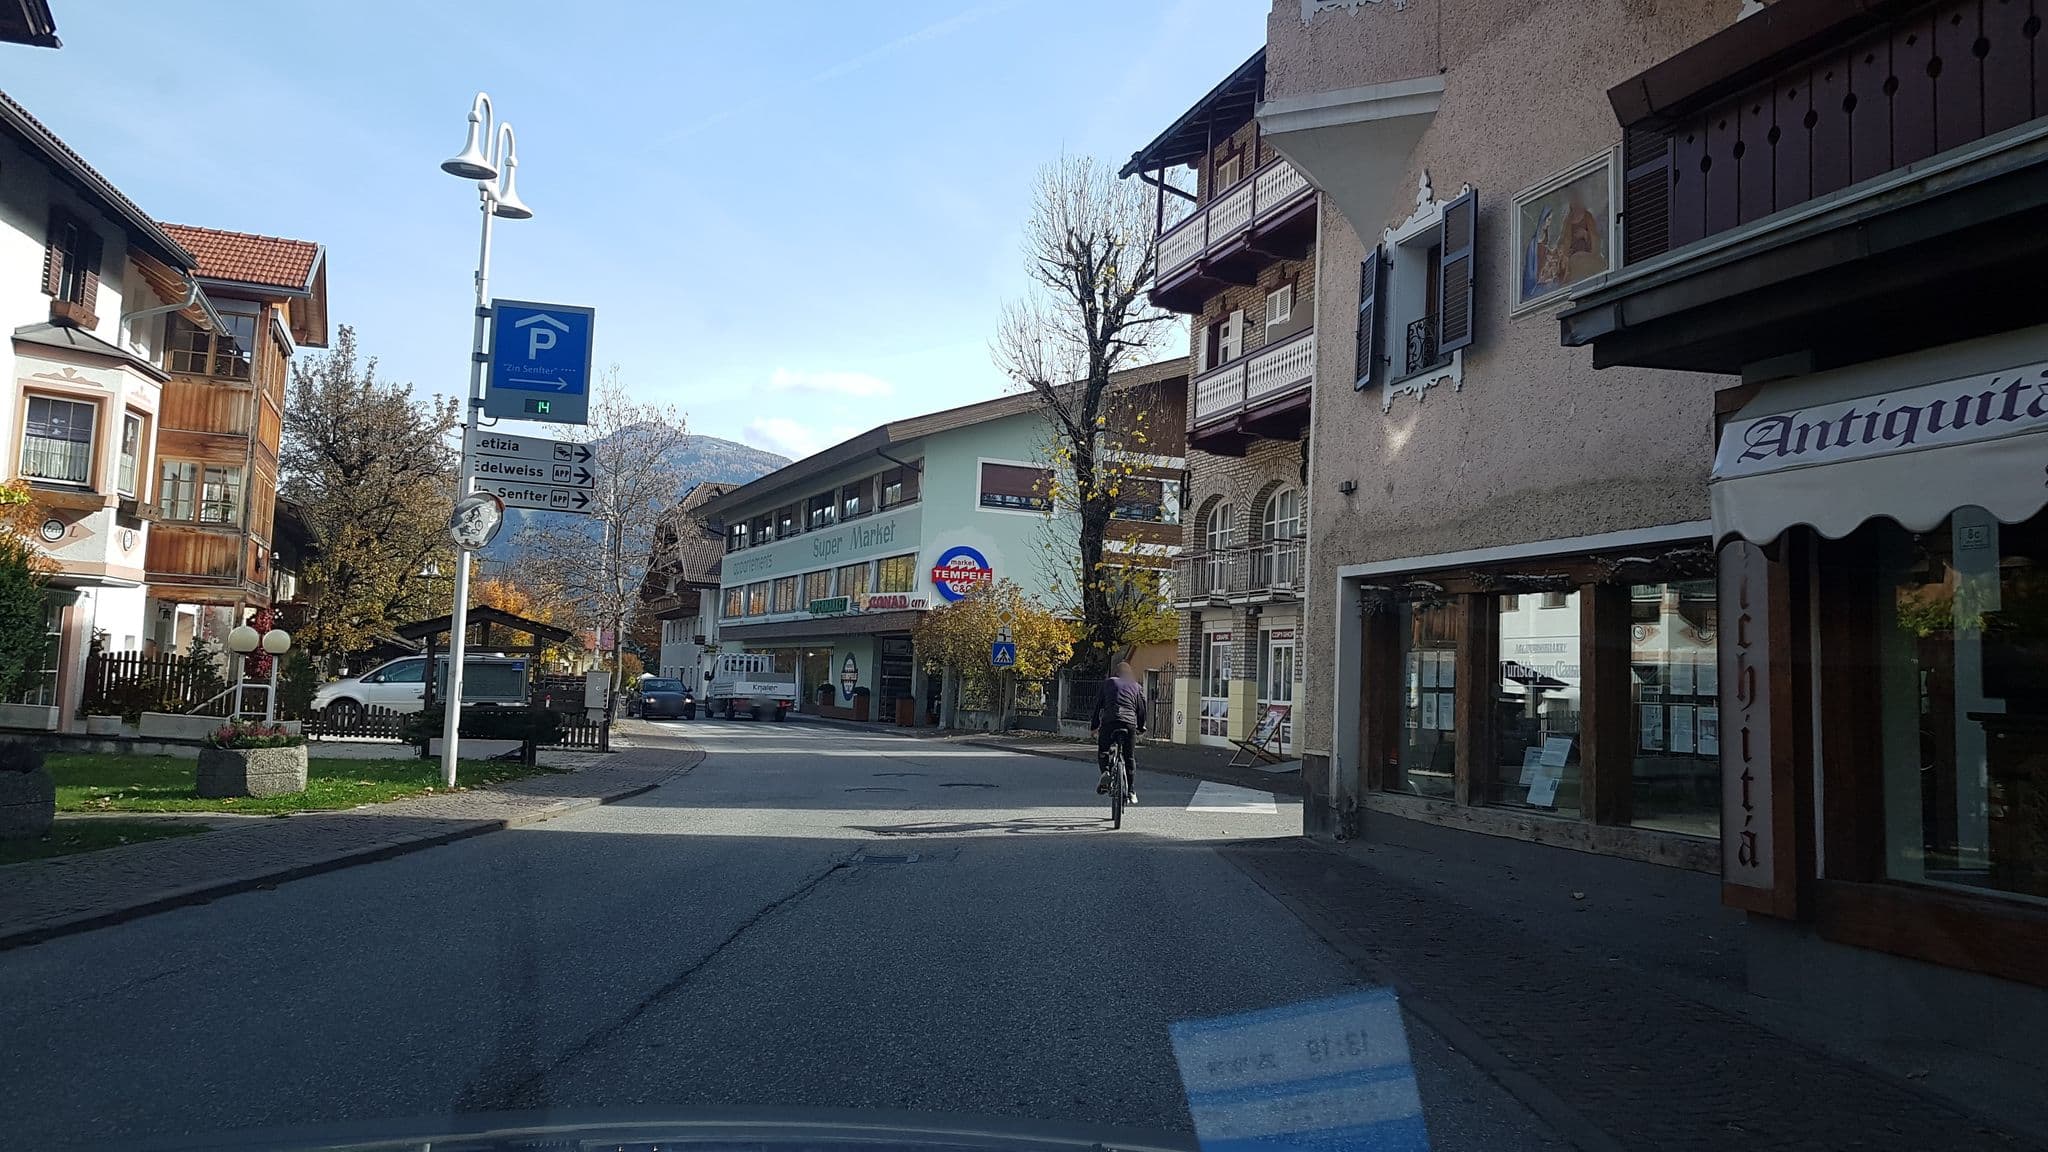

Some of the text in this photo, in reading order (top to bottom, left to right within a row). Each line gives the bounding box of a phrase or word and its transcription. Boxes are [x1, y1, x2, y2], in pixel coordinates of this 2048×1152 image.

[528, 327, 557, 360] P
[538, 401, 550, 414] 14
[476, 438, 520, 453] etizia
[497, 487, 548, 503] Senfter
[813, 519, 896, 560] Super Market
[950, 559, 976, 567] market
